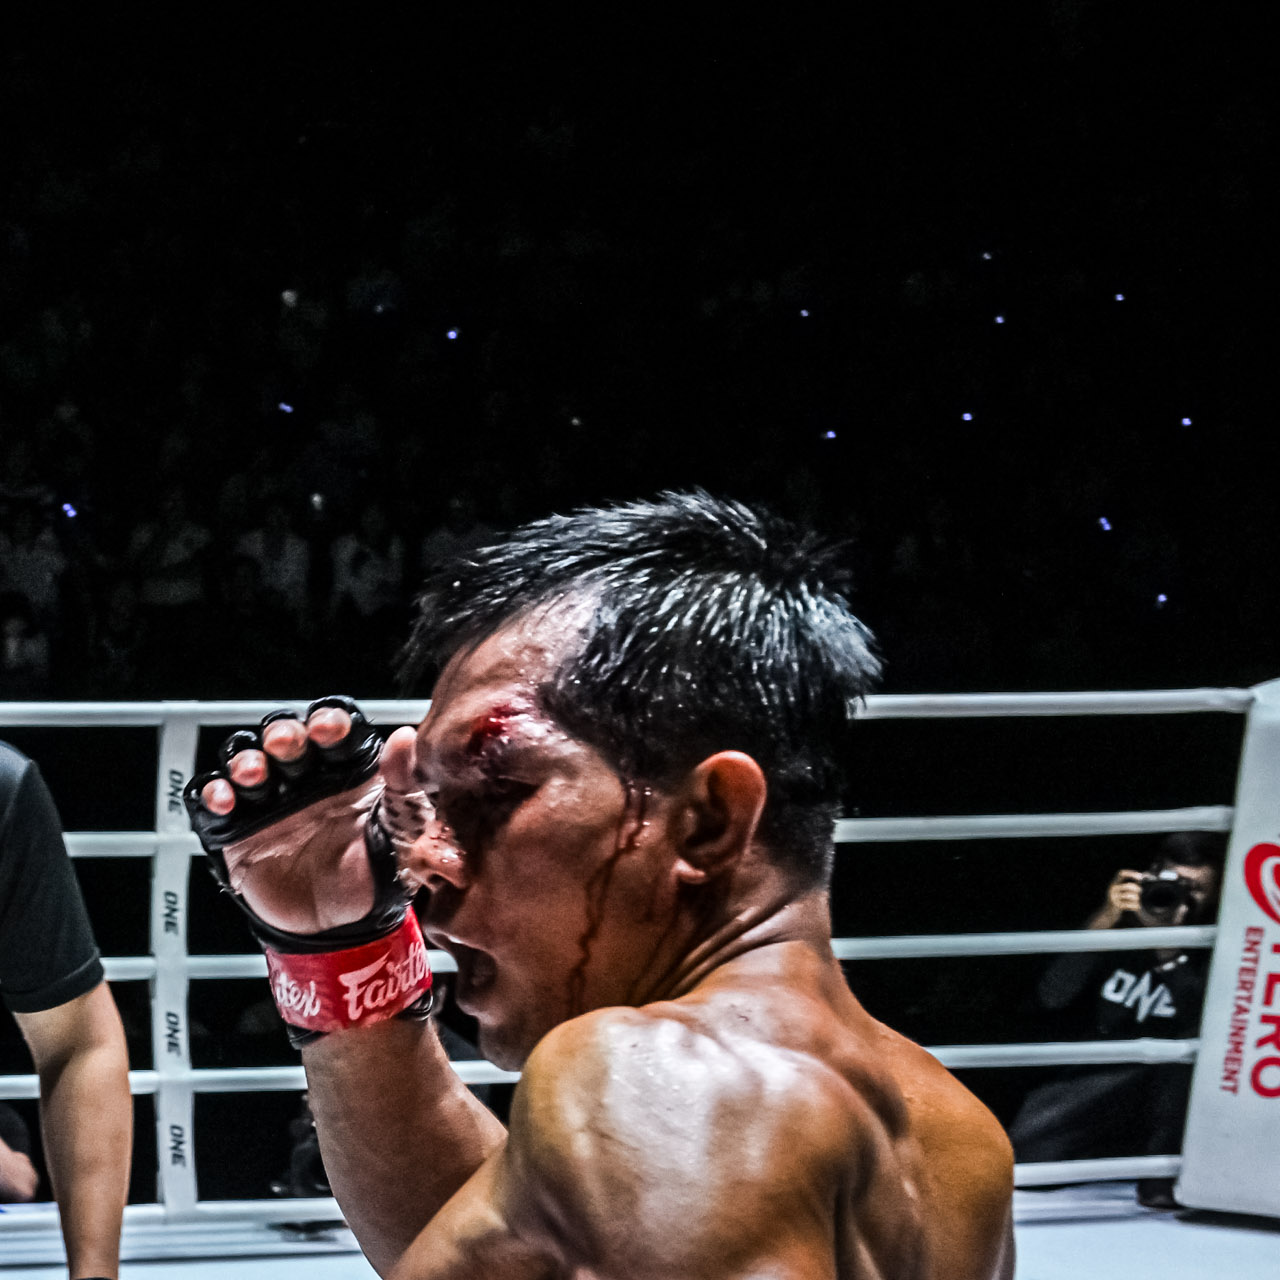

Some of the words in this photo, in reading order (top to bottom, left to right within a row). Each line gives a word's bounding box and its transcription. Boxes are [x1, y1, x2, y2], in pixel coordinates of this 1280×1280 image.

[168, 769, 184, 816] ONE
[162, 890, 178, 936] ONE
[1101, 968, 1177, 1022] ONE
[1220, 926, 1265, 1096] ENTERTAINMENT
[165, 1010, 182, 1057] ONE
[170, 1124, 186, 1168] ONE
